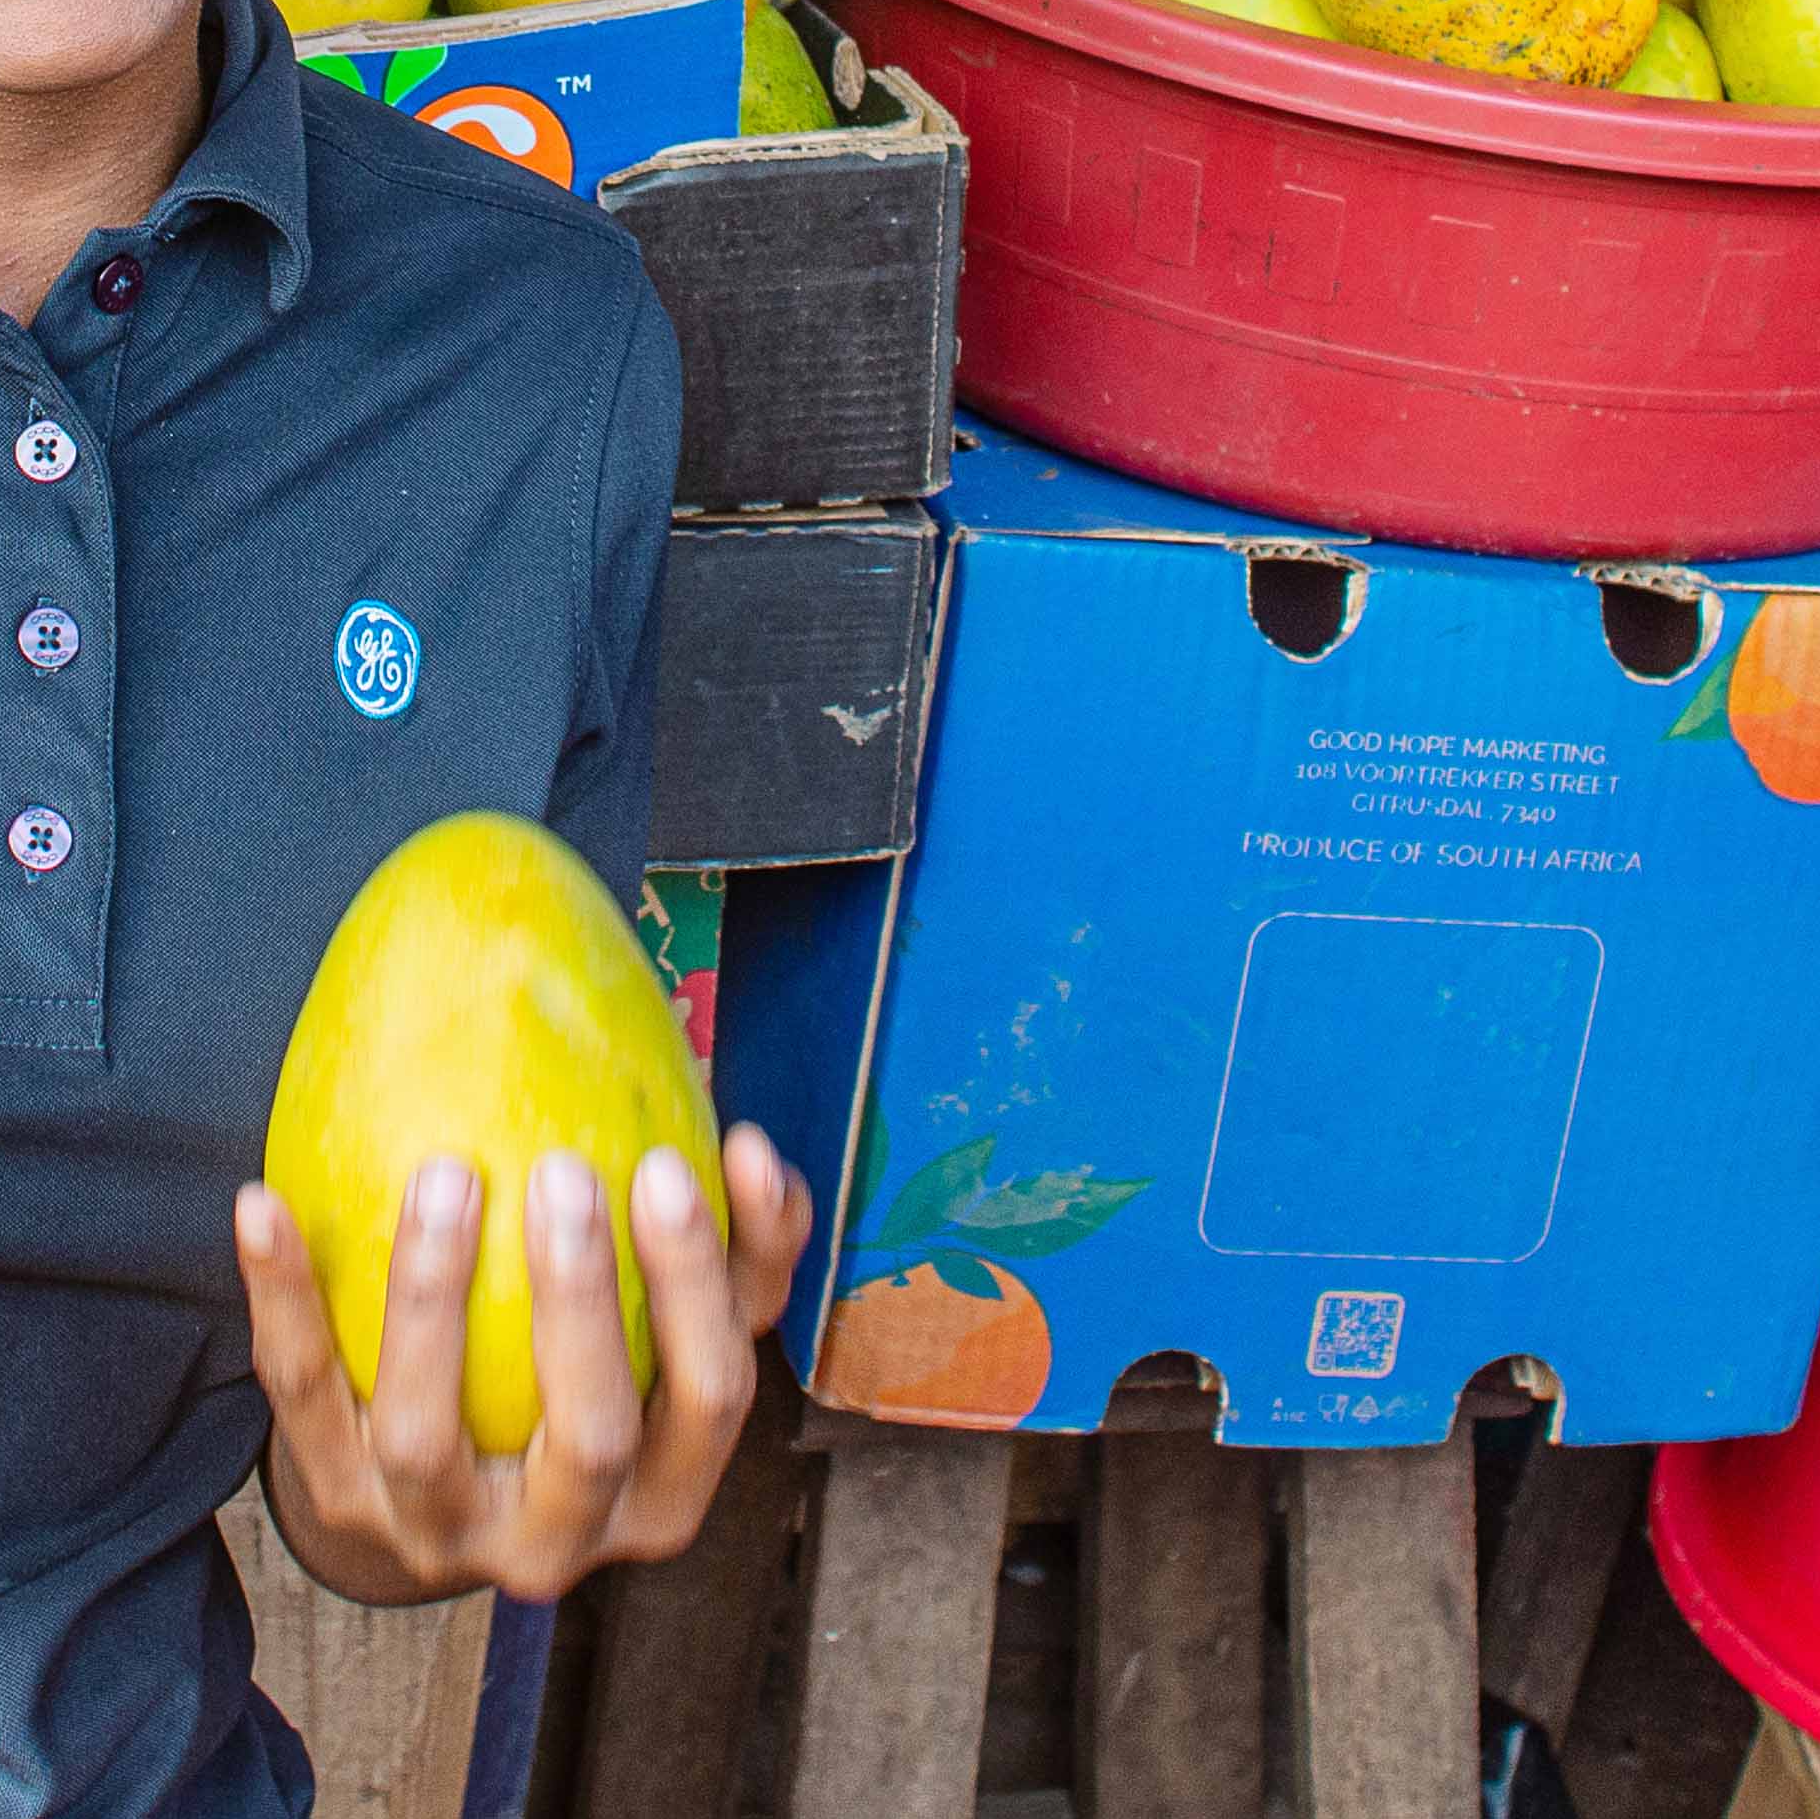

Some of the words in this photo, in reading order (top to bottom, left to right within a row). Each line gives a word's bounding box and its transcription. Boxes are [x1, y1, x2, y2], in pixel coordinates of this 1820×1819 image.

[556, 74, 592, 96] TM
[1309, 729, 1381, 752] GOOD
[1389, 733, 1456, 757] HOPE
[1345, 761, 1525, 791] VOORTREKKER
[1531, 772, 1620, 796] STREET
[1501, 803, 1556, 825] 7340
[1242, 831, 1384, 863] PRODUCE
[1391, 841, 1424, 865] OF
[1437, 844, 1537, 869] SOUTH
[1543, 849, 1643, 874] AFRICA
